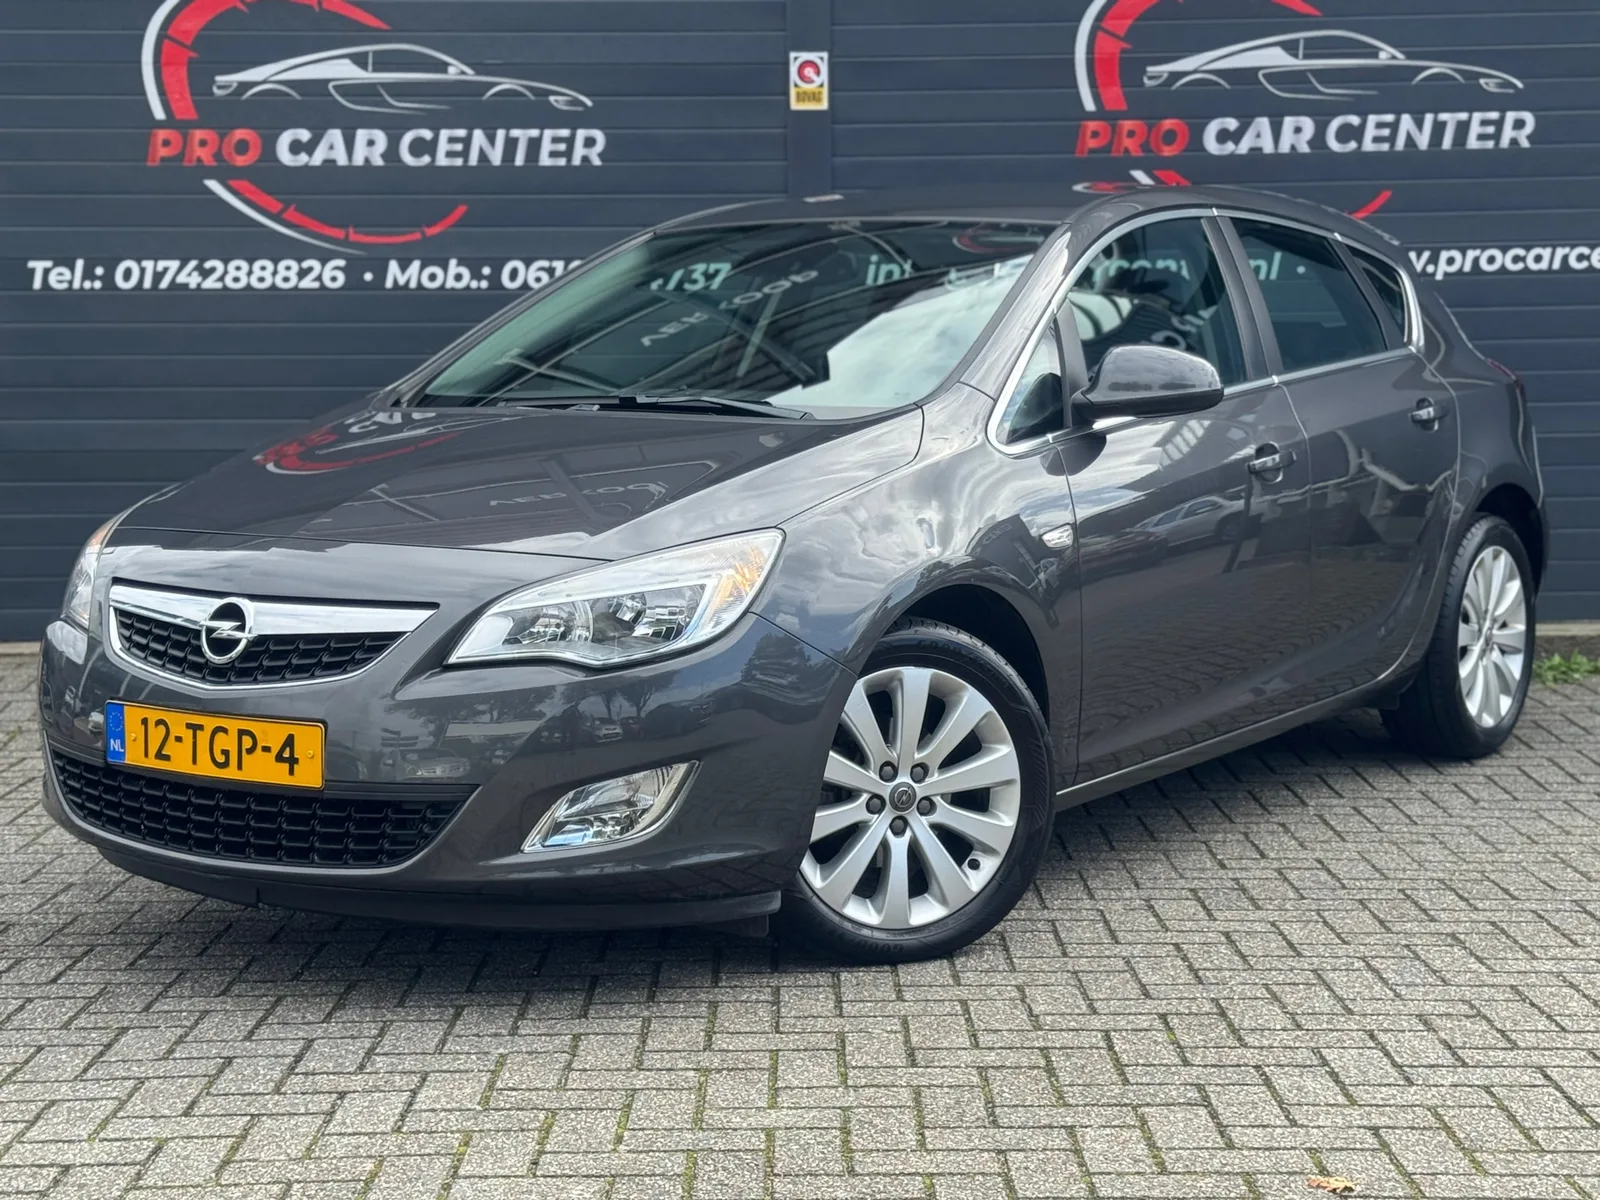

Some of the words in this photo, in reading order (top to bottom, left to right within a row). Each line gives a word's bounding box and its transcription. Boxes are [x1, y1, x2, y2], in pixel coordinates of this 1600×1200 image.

[147, 128, 262, 167] PRO
[275, 128, 388, 167] CAR
[399, 128, 606, 167] CENTER
[1075, 118, 1190, 157] PRO
[1202, 115, 1315, 156] CAR
[1325, 110, 1536, 154] CENTER
[27, 258, 104, 290] Tel.:
[114, 258, 347, 290] 0174288826
[385, 258, 492, 290] Mob.:
[110, 738, 124, 752] NL
[141, 716, 299, 776] 12-TGP-4
